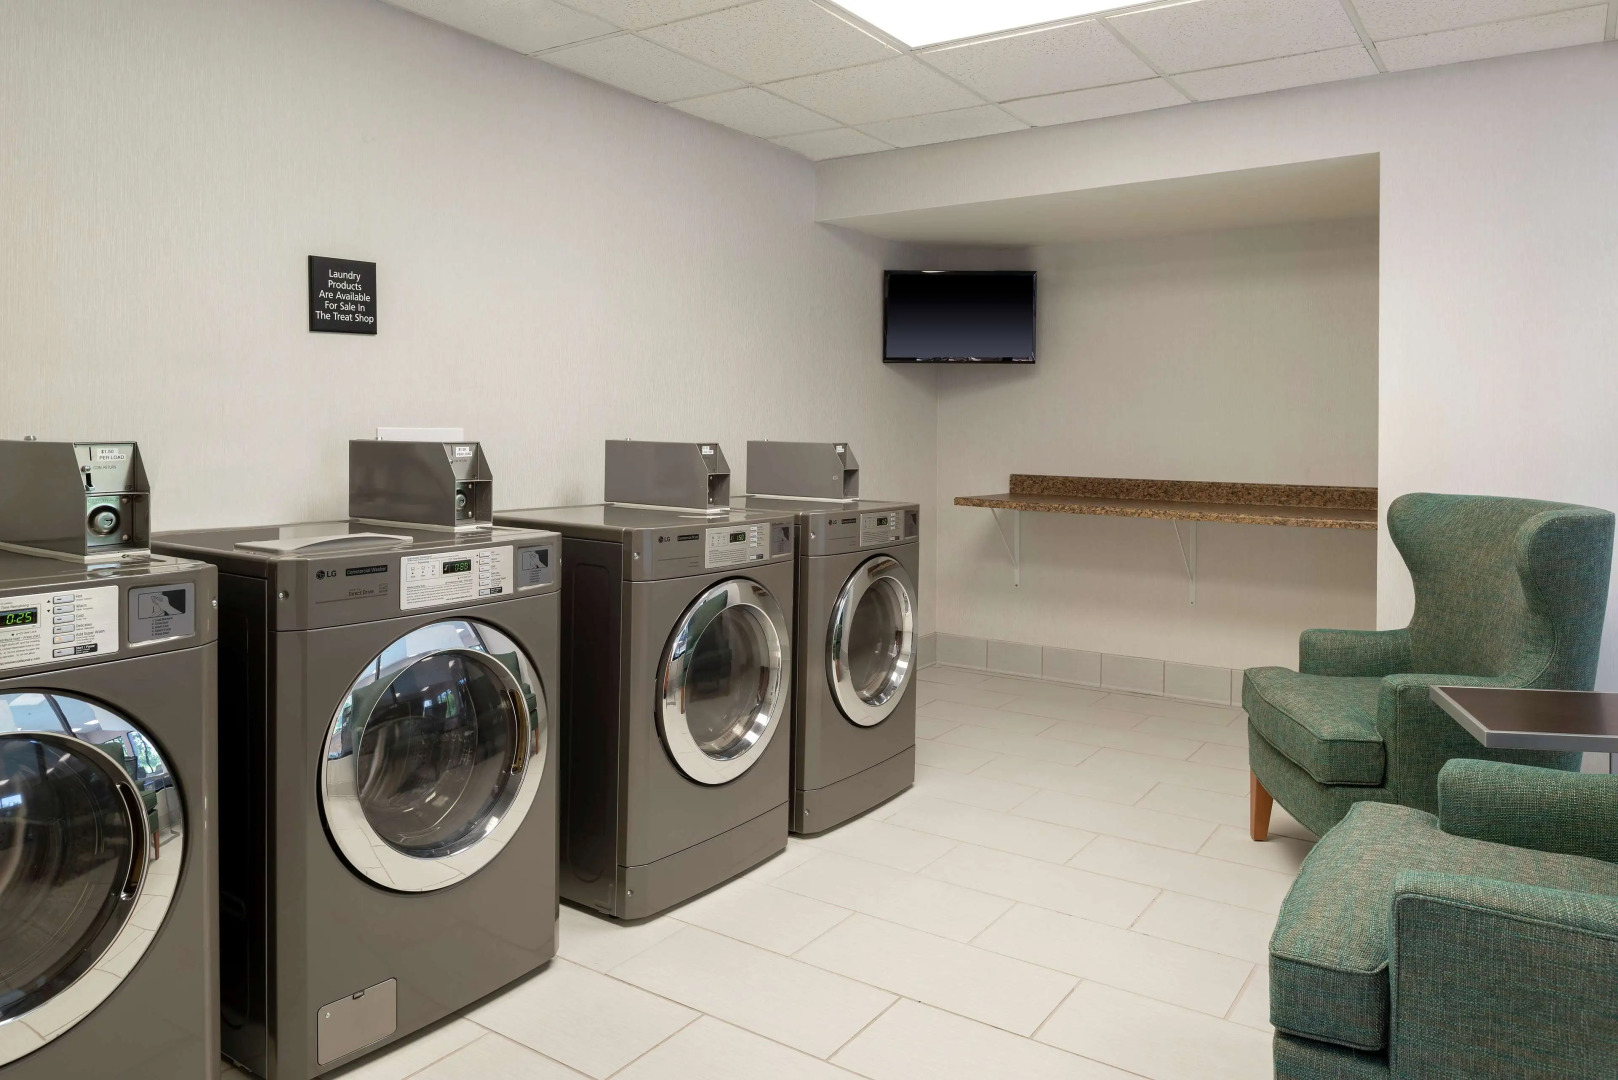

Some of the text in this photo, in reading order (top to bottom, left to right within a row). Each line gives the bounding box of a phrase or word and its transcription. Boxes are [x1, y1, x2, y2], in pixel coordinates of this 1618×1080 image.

[328, 269, 360, 282] Laundry
[328, 280, 362, 290] Products
[319, 290, 370, 302] Are Available
[325, 301, 338, 309] For
[340, 302, 355, 311] Sale
[315, 311, 374, 324] The Treat Shop
